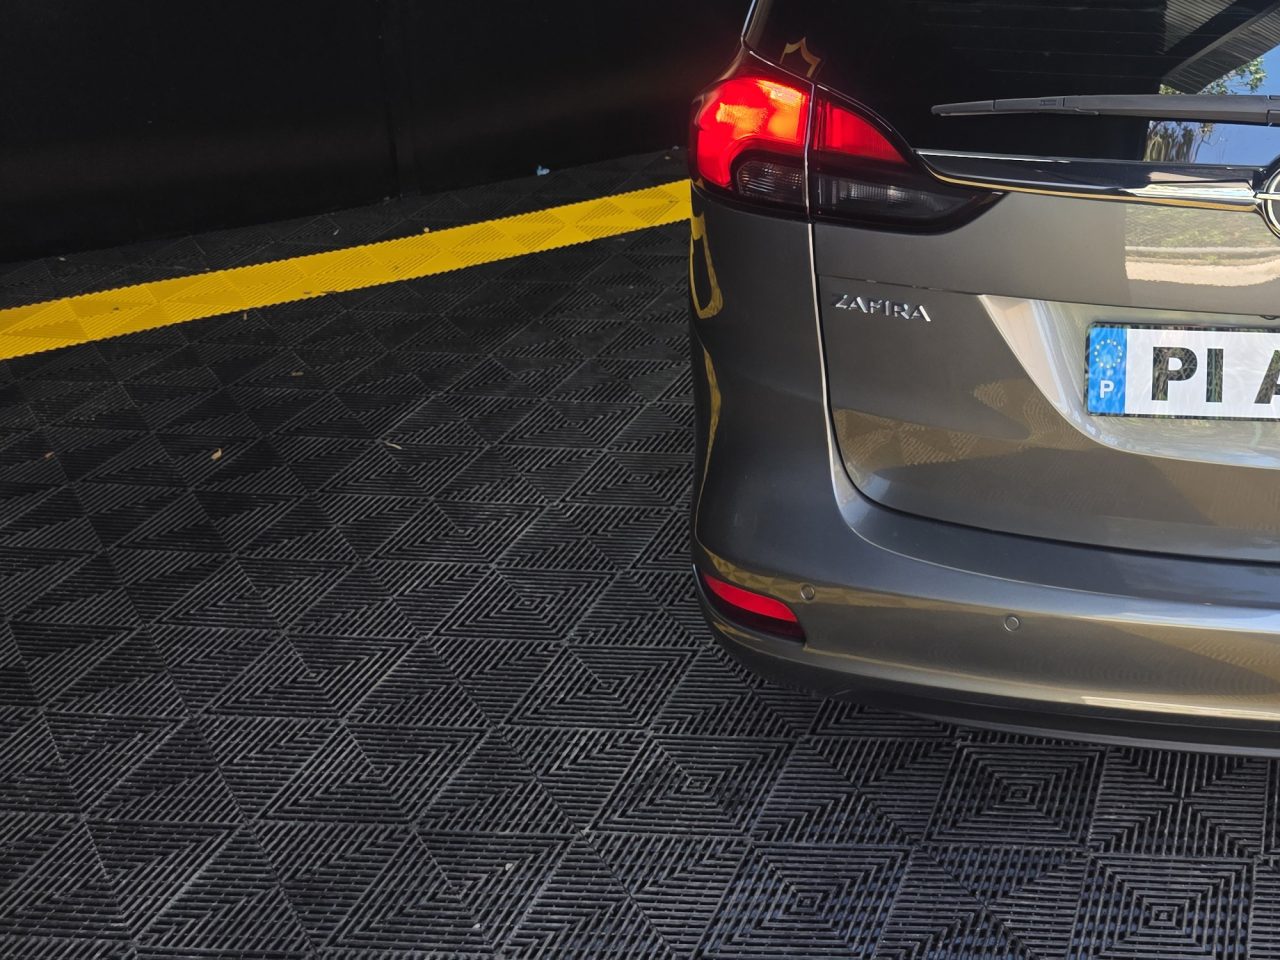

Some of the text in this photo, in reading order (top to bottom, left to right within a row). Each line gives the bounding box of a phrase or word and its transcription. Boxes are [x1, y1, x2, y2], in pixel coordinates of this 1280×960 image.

[832, 294, 932, 322] ZAFIRA
[1151, 346, 1224, 403] PI
[1099, 380, 1115, 399] P
